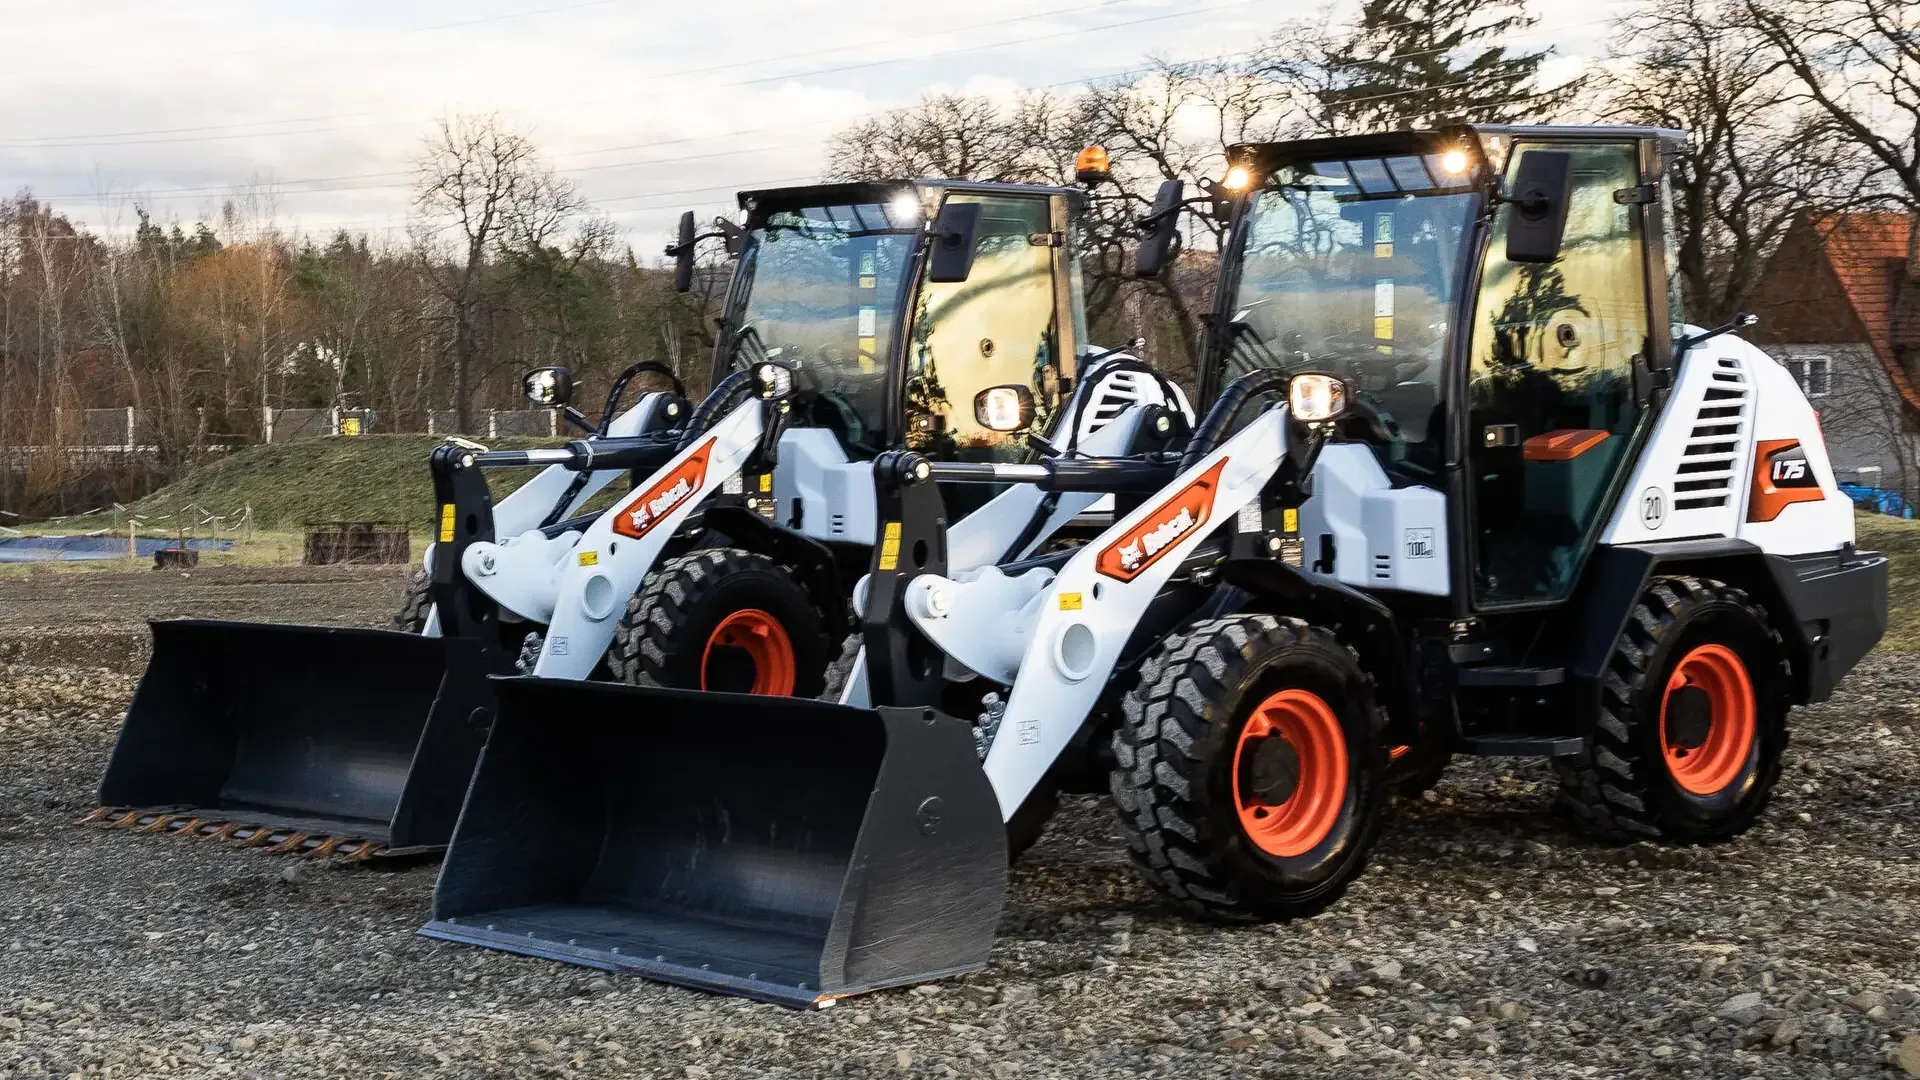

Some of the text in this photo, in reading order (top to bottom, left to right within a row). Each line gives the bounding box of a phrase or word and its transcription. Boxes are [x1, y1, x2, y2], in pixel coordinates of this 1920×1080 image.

[648, 477, 690, 518] Bobcat
[1644, 496, 1661, 521] 20
[1141, 506, 1194, 557] Bobcat
